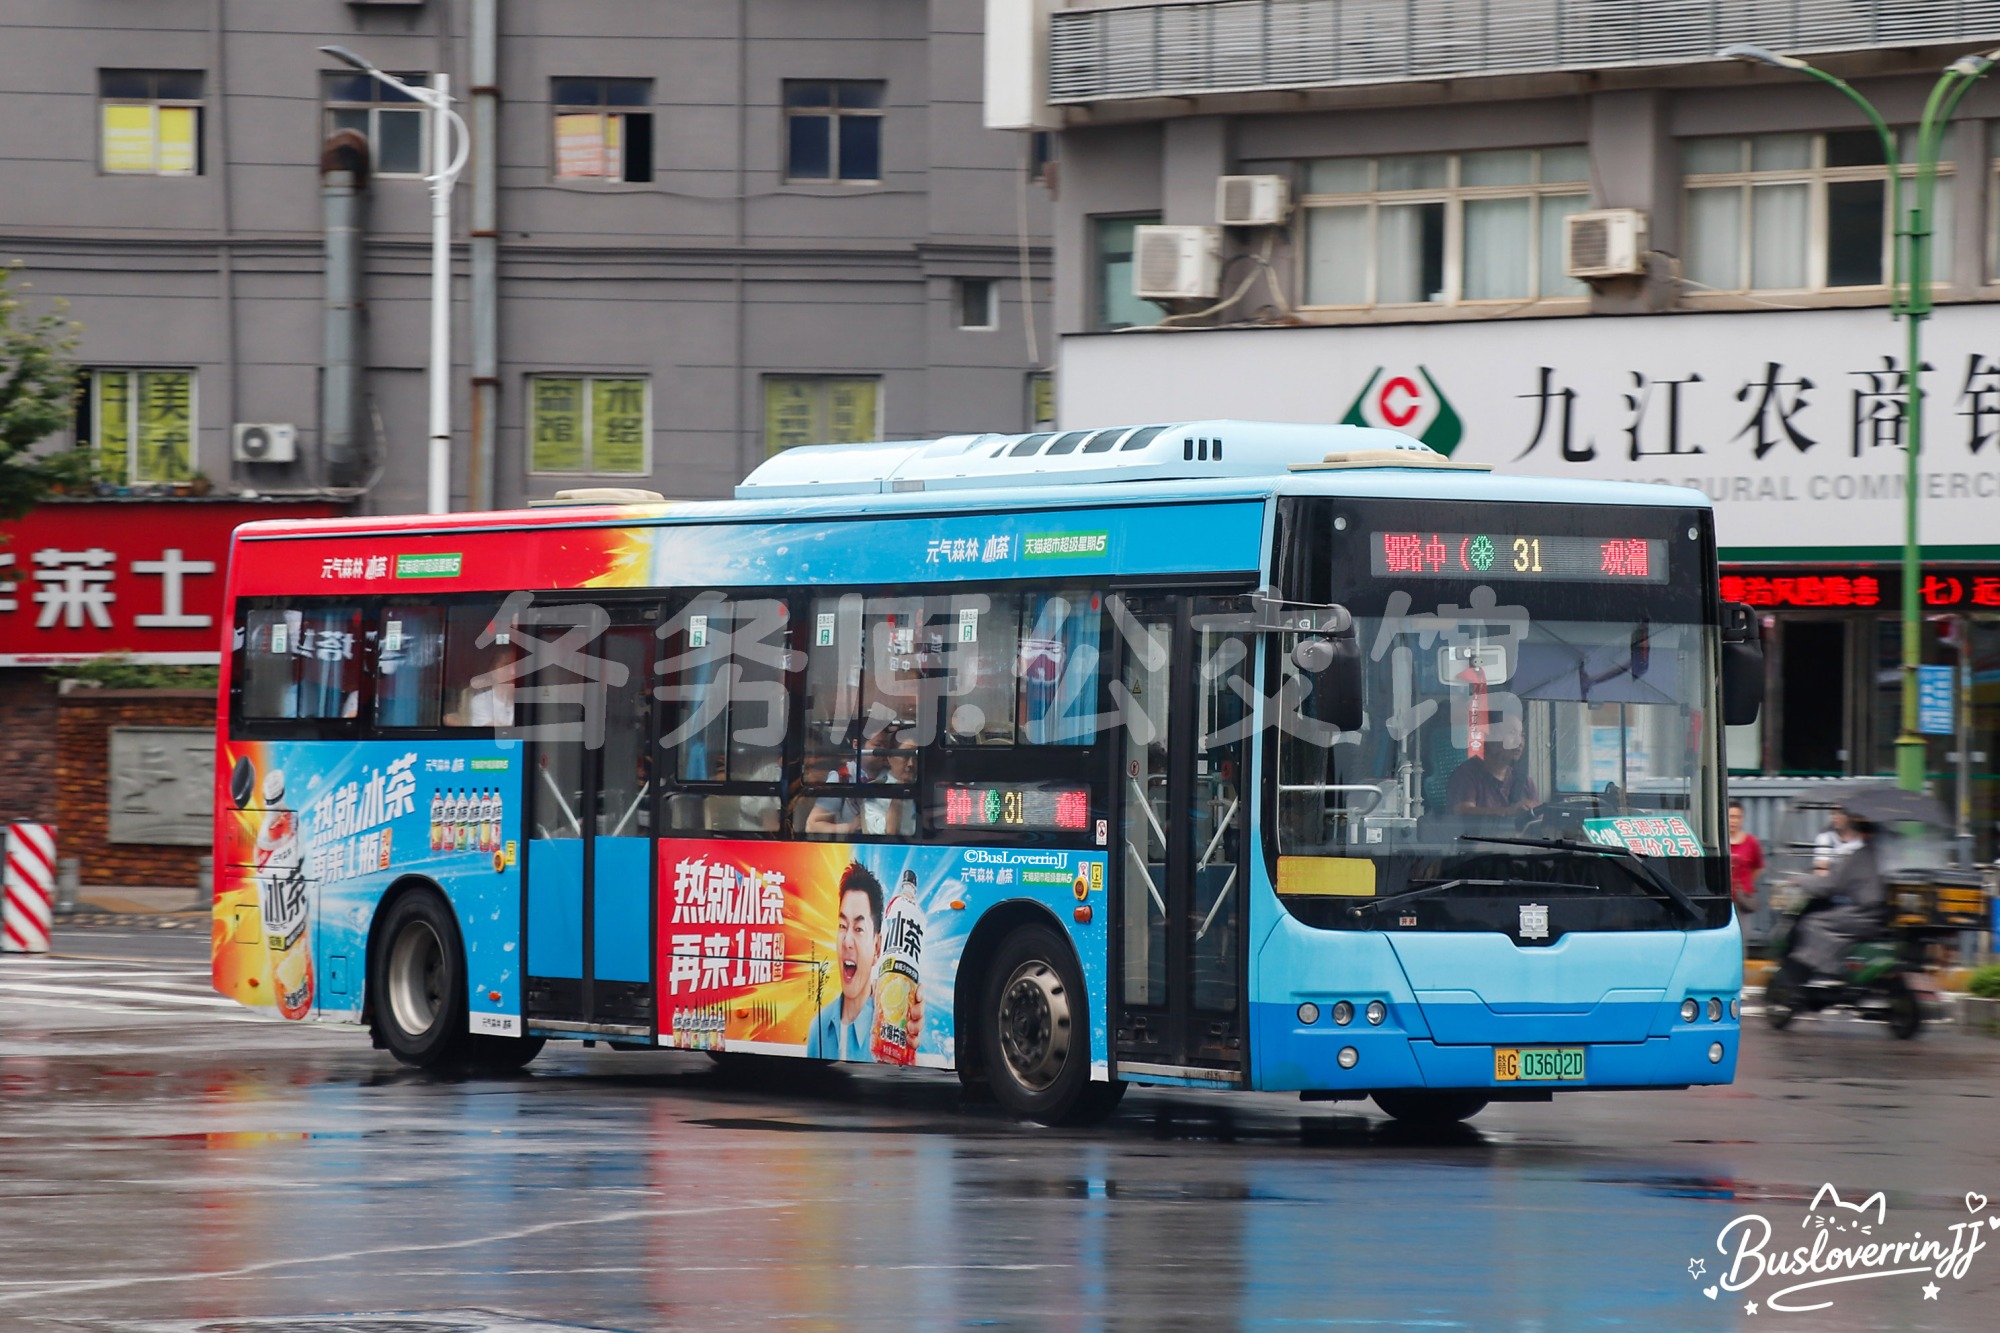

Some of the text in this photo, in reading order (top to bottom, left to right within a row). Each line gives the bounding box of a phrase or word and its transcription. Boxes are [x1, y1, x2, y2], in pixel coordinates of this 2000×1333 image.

[926, 538, 979, 563] 元气森林
[1024, 535, 1107, 555] 天猫超市超级星期5
[1512, 538, 1543, 572] 31
[0, 548, 216, 628] 莱士
[313, 752, 418, 850] 热就冰茶
[1004, 791, 1024, 824] 31
[1614, 818, 1690, 836] 空调开启
[311, 832, 381, 889] 再来1瓶
[1626, 837, 1700, 857] 票价2元
[671, 855, 786, 925] 热就冰茶
[961, 867, 994, 883] 元气森林
[669, 929, 774, 995] 再来1瓶
[1524, 1052, 1583, 1077] 03602D
